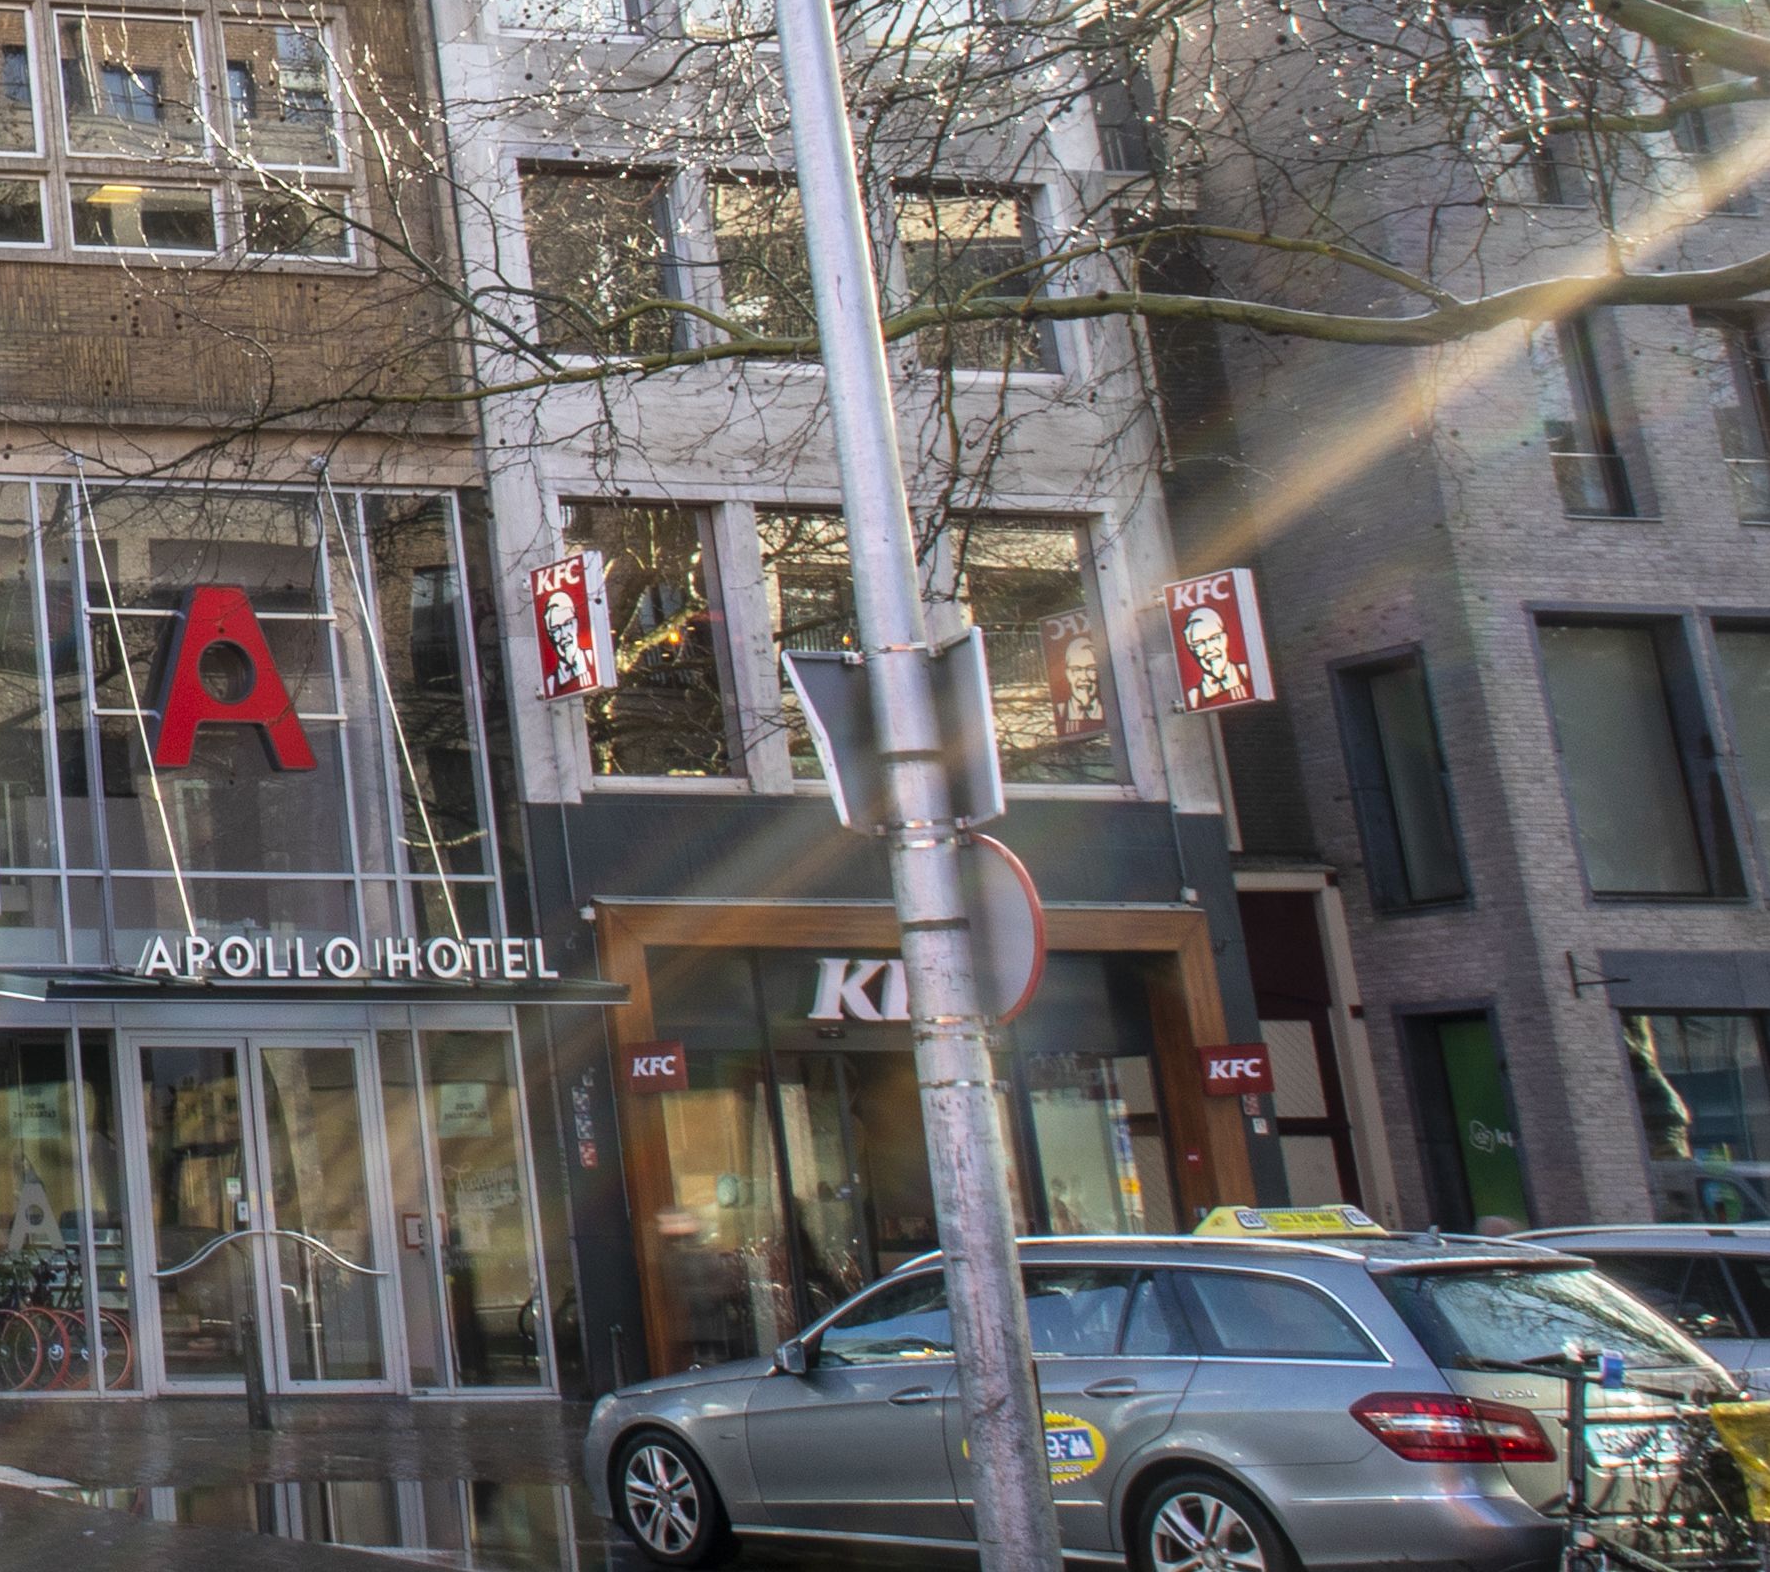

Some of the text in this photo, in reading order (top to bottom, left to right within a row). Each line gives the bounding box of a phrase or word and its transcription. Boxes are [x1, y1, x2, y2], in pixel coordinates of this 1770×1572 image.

[536, 559, 580, 596] KFC
[1172, 573, 1231, 610] KFC
[144, 936, 559, 979] APOLLO HOTEL
[631, 1055, 676, 1077] KFC
[1209, 1058, 1262, 1080] KFC
